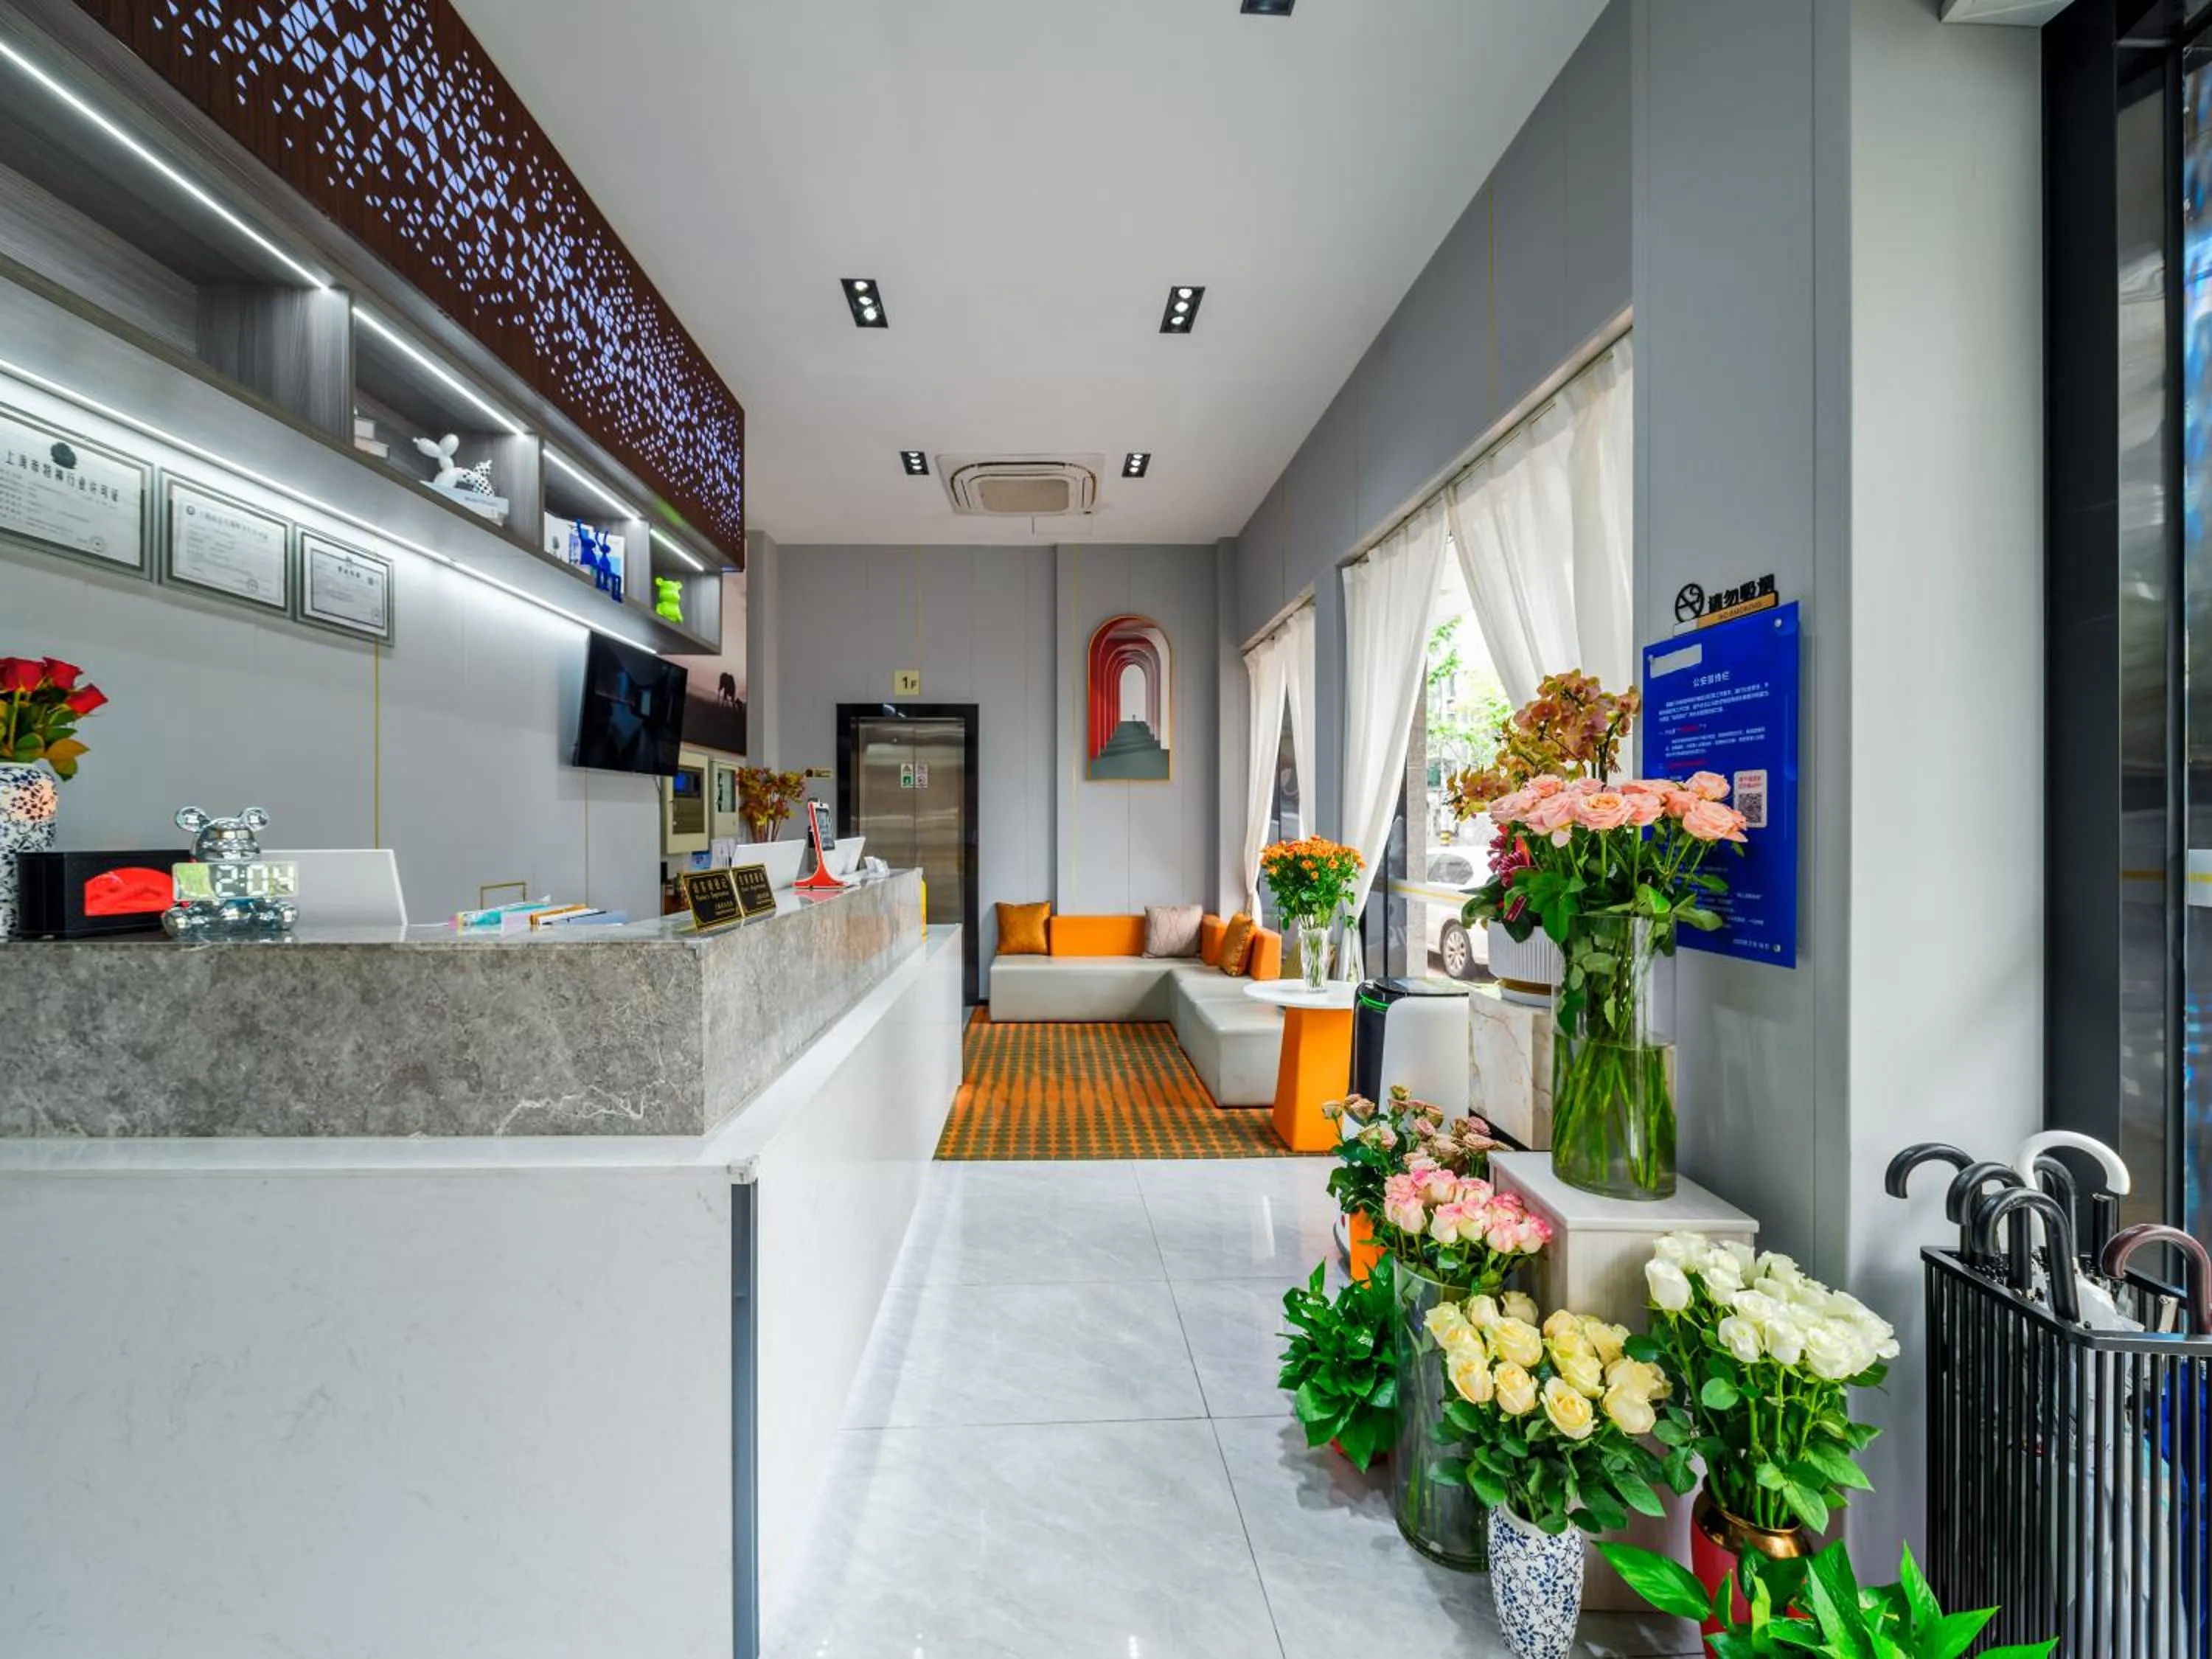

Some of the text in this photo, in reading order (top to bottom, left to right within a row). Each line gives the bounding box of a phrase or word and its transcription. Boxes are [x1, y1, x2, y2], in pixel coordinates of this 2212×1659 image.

[1708, 574, 1775, 613] 请勿吸烟
[902, 676, 917, 689] 1F
